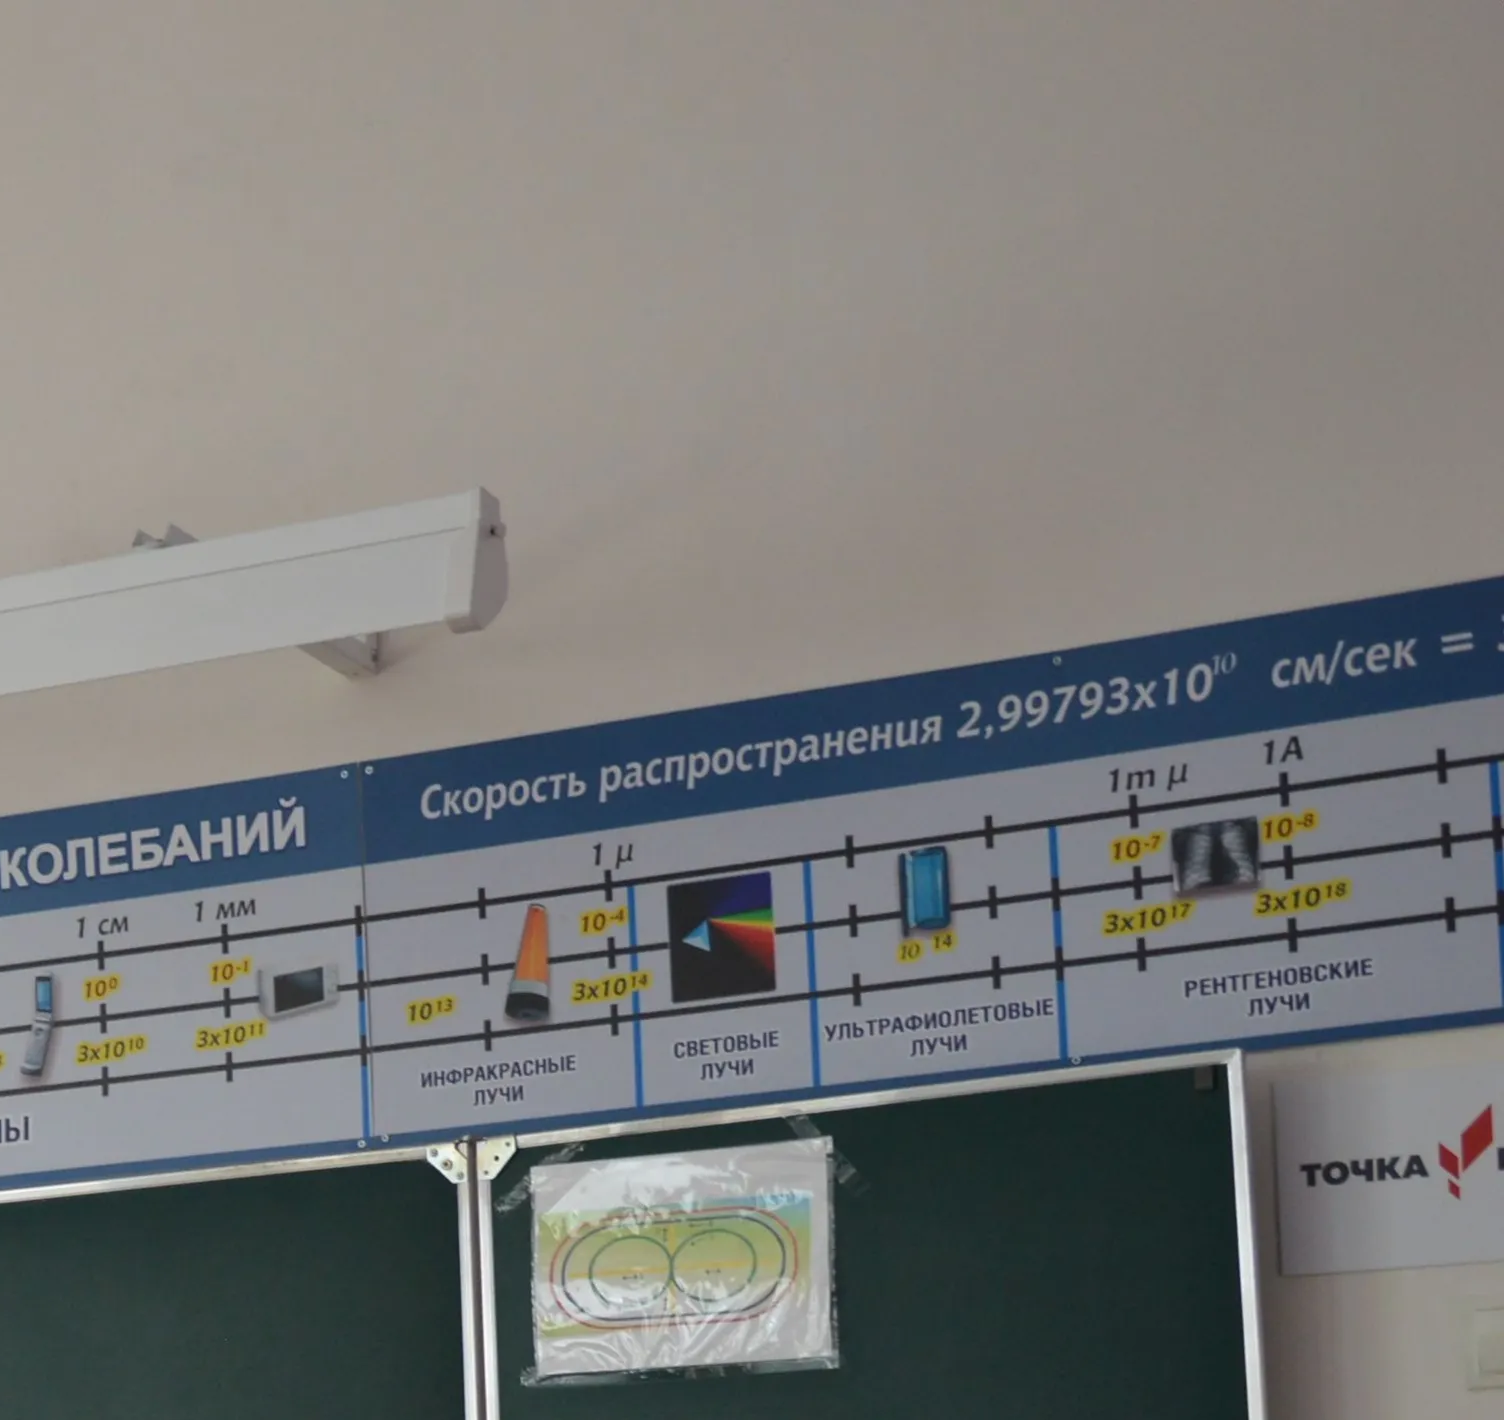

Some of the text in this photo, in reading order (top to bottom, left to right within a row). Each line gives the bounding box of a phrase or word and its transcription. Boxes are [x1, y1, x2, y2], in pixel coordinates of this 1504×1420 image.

[420, 769, 587, 820] Скорость
[599, 714, 943, 802] распространения
[1270, 637, 1419, 688] см/сек
[593, 843, 602, 866] 1
[194, 901, 203, 922] 1
[77, 917, 86, 938] 1
[1184, 958, 1373, 997] РЕНТГЕНОВСКИЕ
[1247, 993, 1310, 1017] ЛУЧИ
[823, 998, 1054, 1041] УЛЬТРАФИОЛЕТОВЫЕ
[673, 1031, 779, 1059] СВЕТОВЫЕ
[909, 1035, 968, 1057] ЛУЧИ
[420, 1055, 576, 1088] ИНФРАКРАСНЫЕ
[700, 1059, 754, 1081] ЛУЧИ
[473, 1085, 524, 1106] ЛУЧИ
[1300, 1154, 1429, 1187] ТОЧКА
